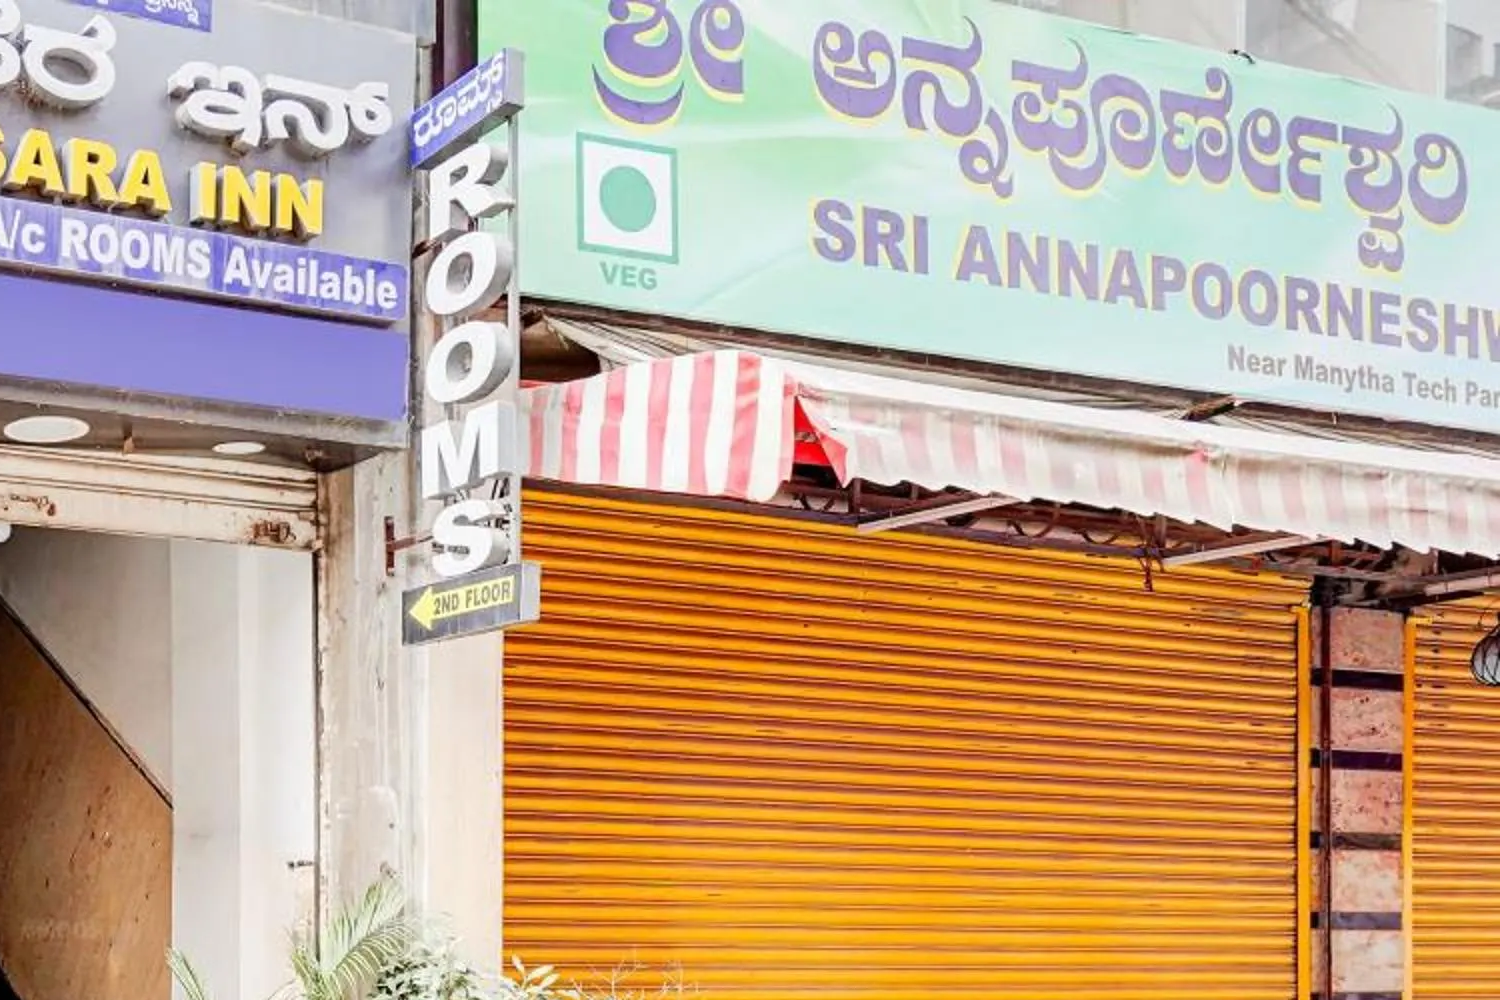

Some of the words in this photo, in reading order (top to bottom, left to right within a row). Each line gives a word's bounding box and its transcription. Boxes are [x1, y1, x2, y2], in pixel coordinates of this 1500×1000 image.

[168, 61, 392, 157] ಇನ್
[190, 161, 324, 243] INN
[811, 199, 930, 275] SRI
[60, 217, 211, 281] ROOMS
[223, 246, 398, 309] Available
[599, 261, 657, 291] VEG
[421, 141, 517, 578] ROOMS
[1227, 344, 1287, 378] Near
[1294, 354, 1395, 394] Manytha
[1402, 372, 1456, 404] Tech
[433, 594, 460, 615] 2ND
[465, 580, 511, 609] FLOOR
